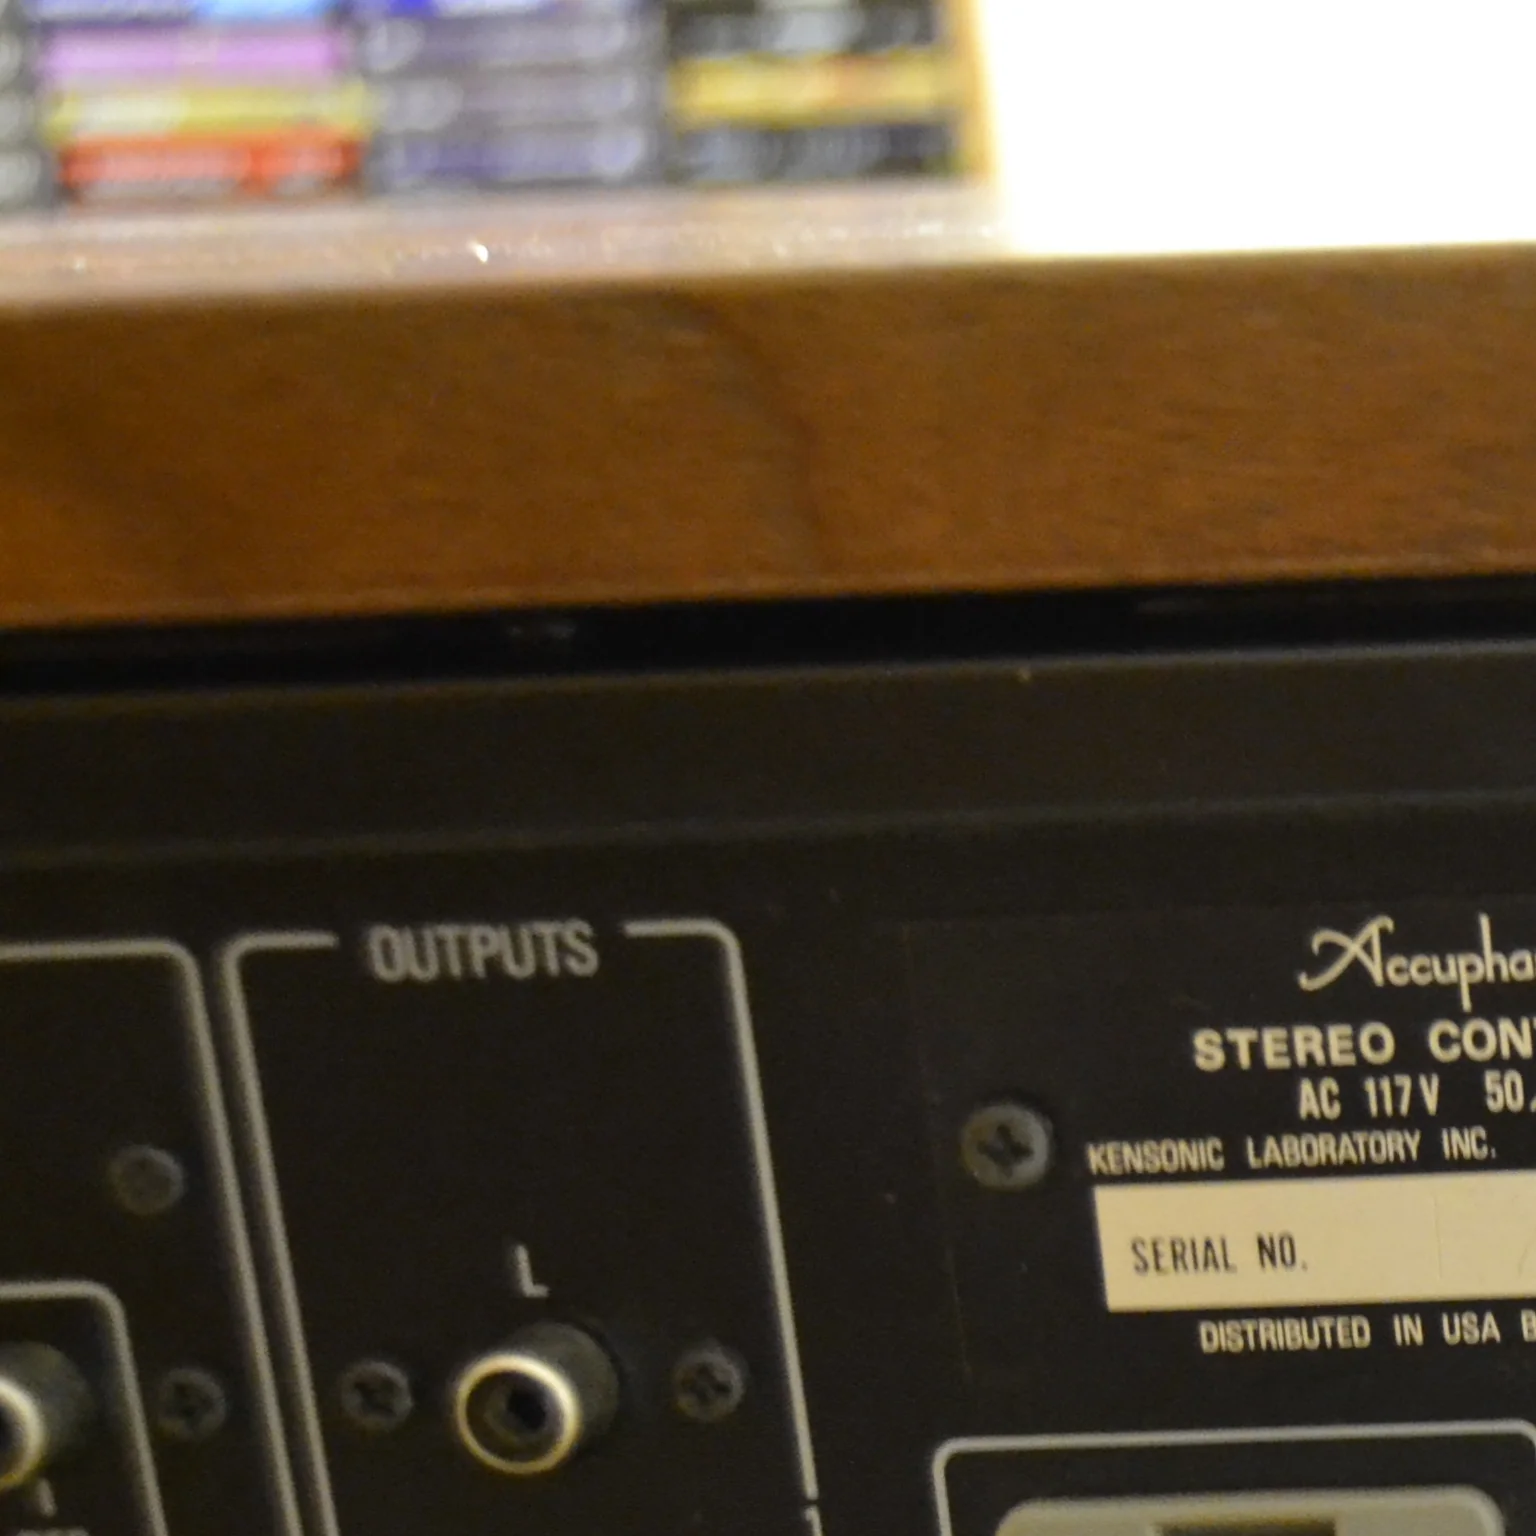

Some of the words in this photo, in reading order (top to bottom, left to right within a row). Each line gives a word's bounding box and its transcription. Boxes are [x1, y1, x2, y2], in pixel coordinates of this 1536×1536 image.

[367, 918, 599, 982] OUTPUTS
[1192, 1021, 1395, 1071] STEREO
[1298, 1077, 1341, 1120] AC
[1364, 1073, 1440, 1117] 117V
[1086, 1137, 1225, 1175] KENSONIC
[1246, 1129, 1421, 1169] LABORATORY
[1441, 1125, 1497, 1161] INC.
[514, 1244, 548, 1298] L
[1131, 1235, 1237, 1276] SERIAL
[1257, 1232, 1308, 1271] NO.
[1198, 1315, 1372, 1353] DISTRIBUTED
[1392, 1314, 1424, 1345] IN
[1441, 1311, 1501, 1345] USA
